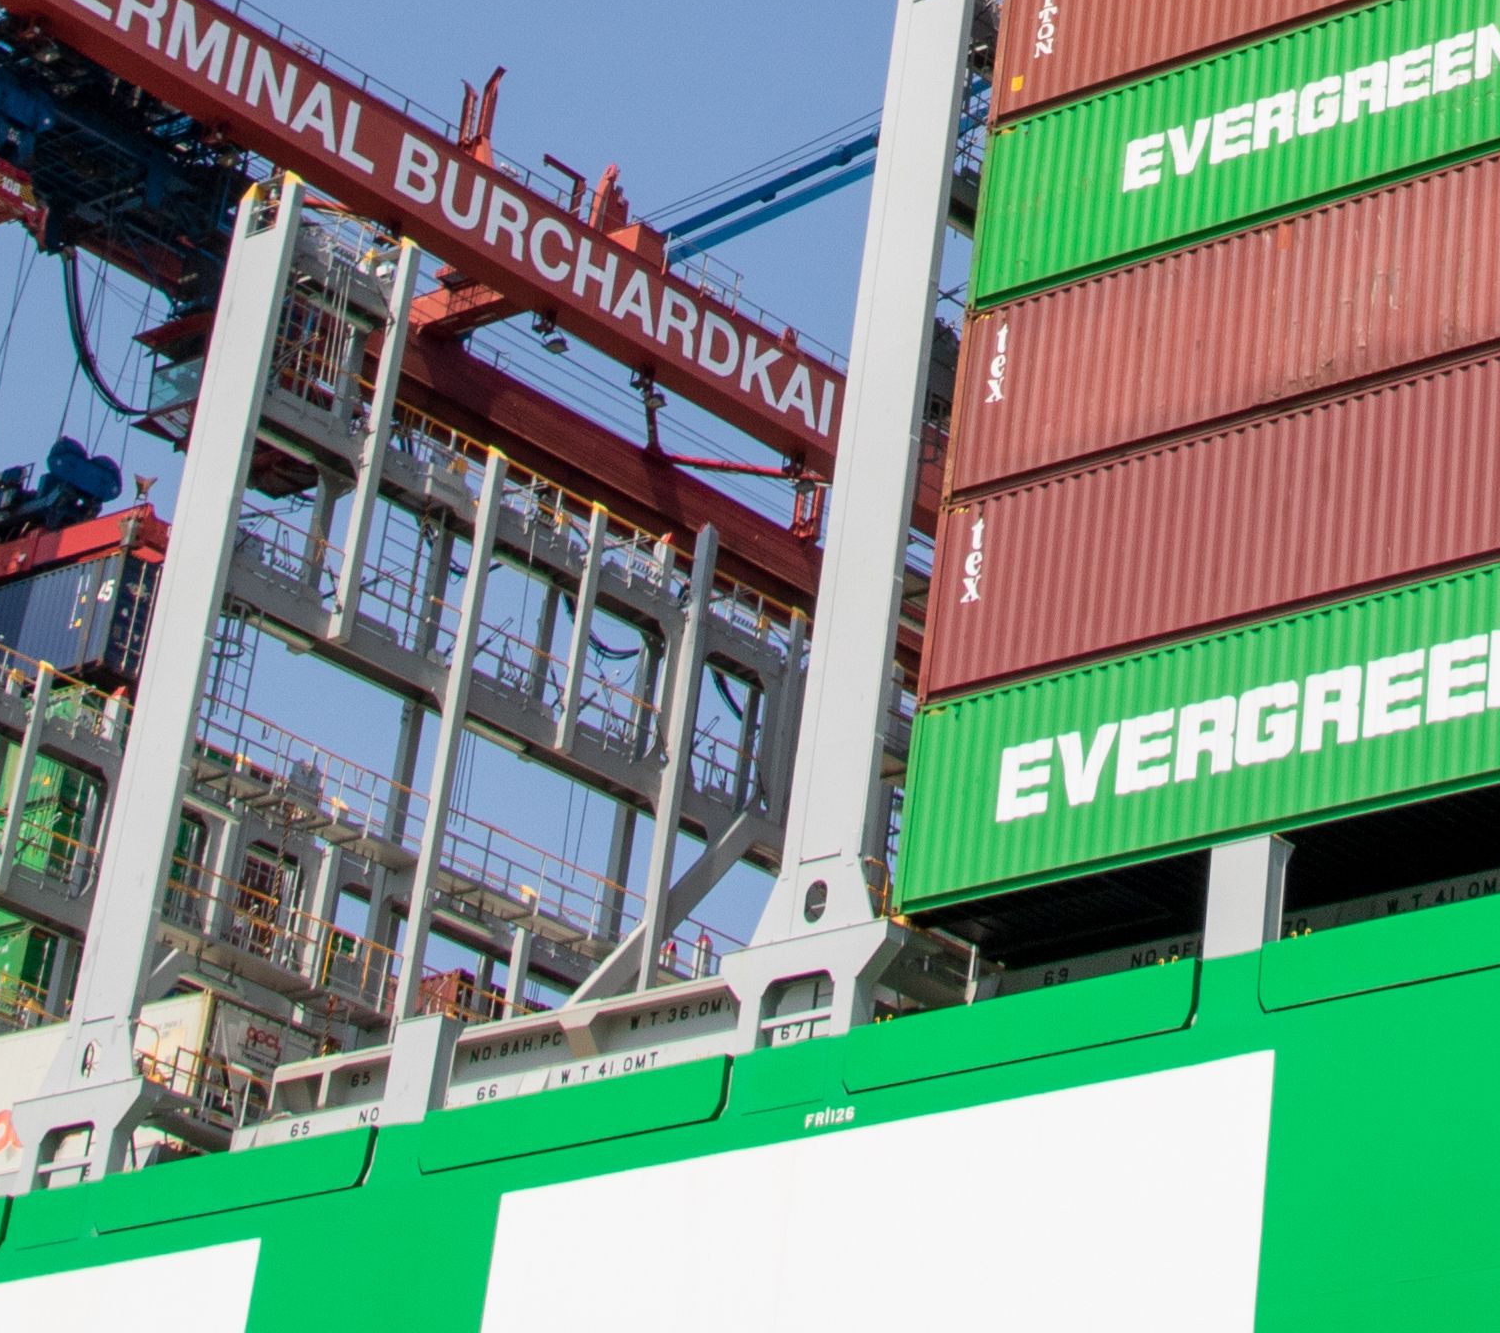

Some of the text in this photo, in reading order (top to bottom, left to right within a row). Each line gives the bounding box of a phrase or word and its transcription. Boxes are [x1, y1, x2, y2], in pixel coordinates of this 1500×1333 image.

[393, 131, 836, 439] BURCHARDKAI
[985, 323, 1011, 404] tex
[959, 517, 989, 605] tex
[1044, 967, 1070, 986] 69
[351, 1070, 372, 1088] 65
[476, 1084, 499, 1101] 66
[290, 1120, 311, 1138] 65
